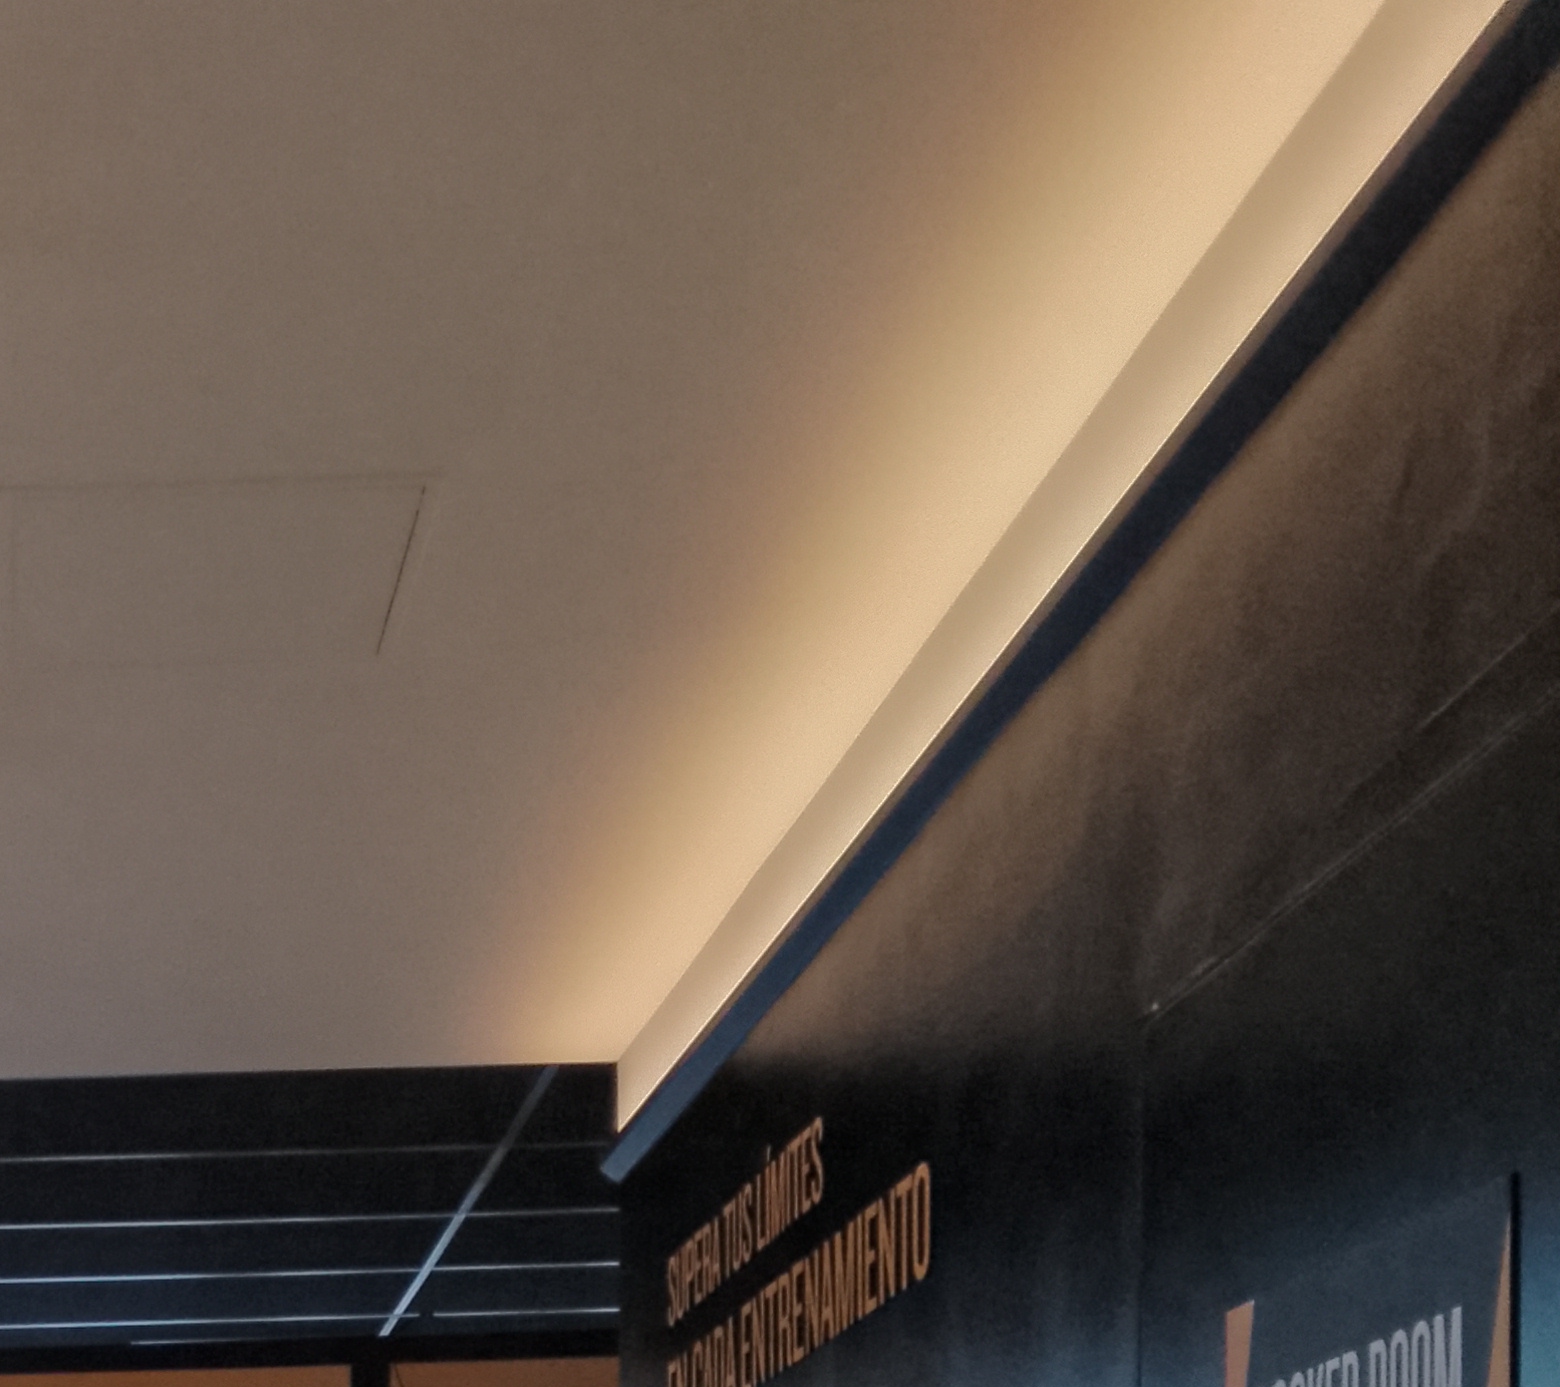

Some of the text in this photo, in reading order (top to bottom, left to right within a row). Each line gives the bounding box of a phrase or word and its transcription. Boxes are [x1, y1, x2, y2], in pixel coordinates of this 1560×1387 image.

[666, 1116, 824, 1327] SUPERA TUS LÍMITES
